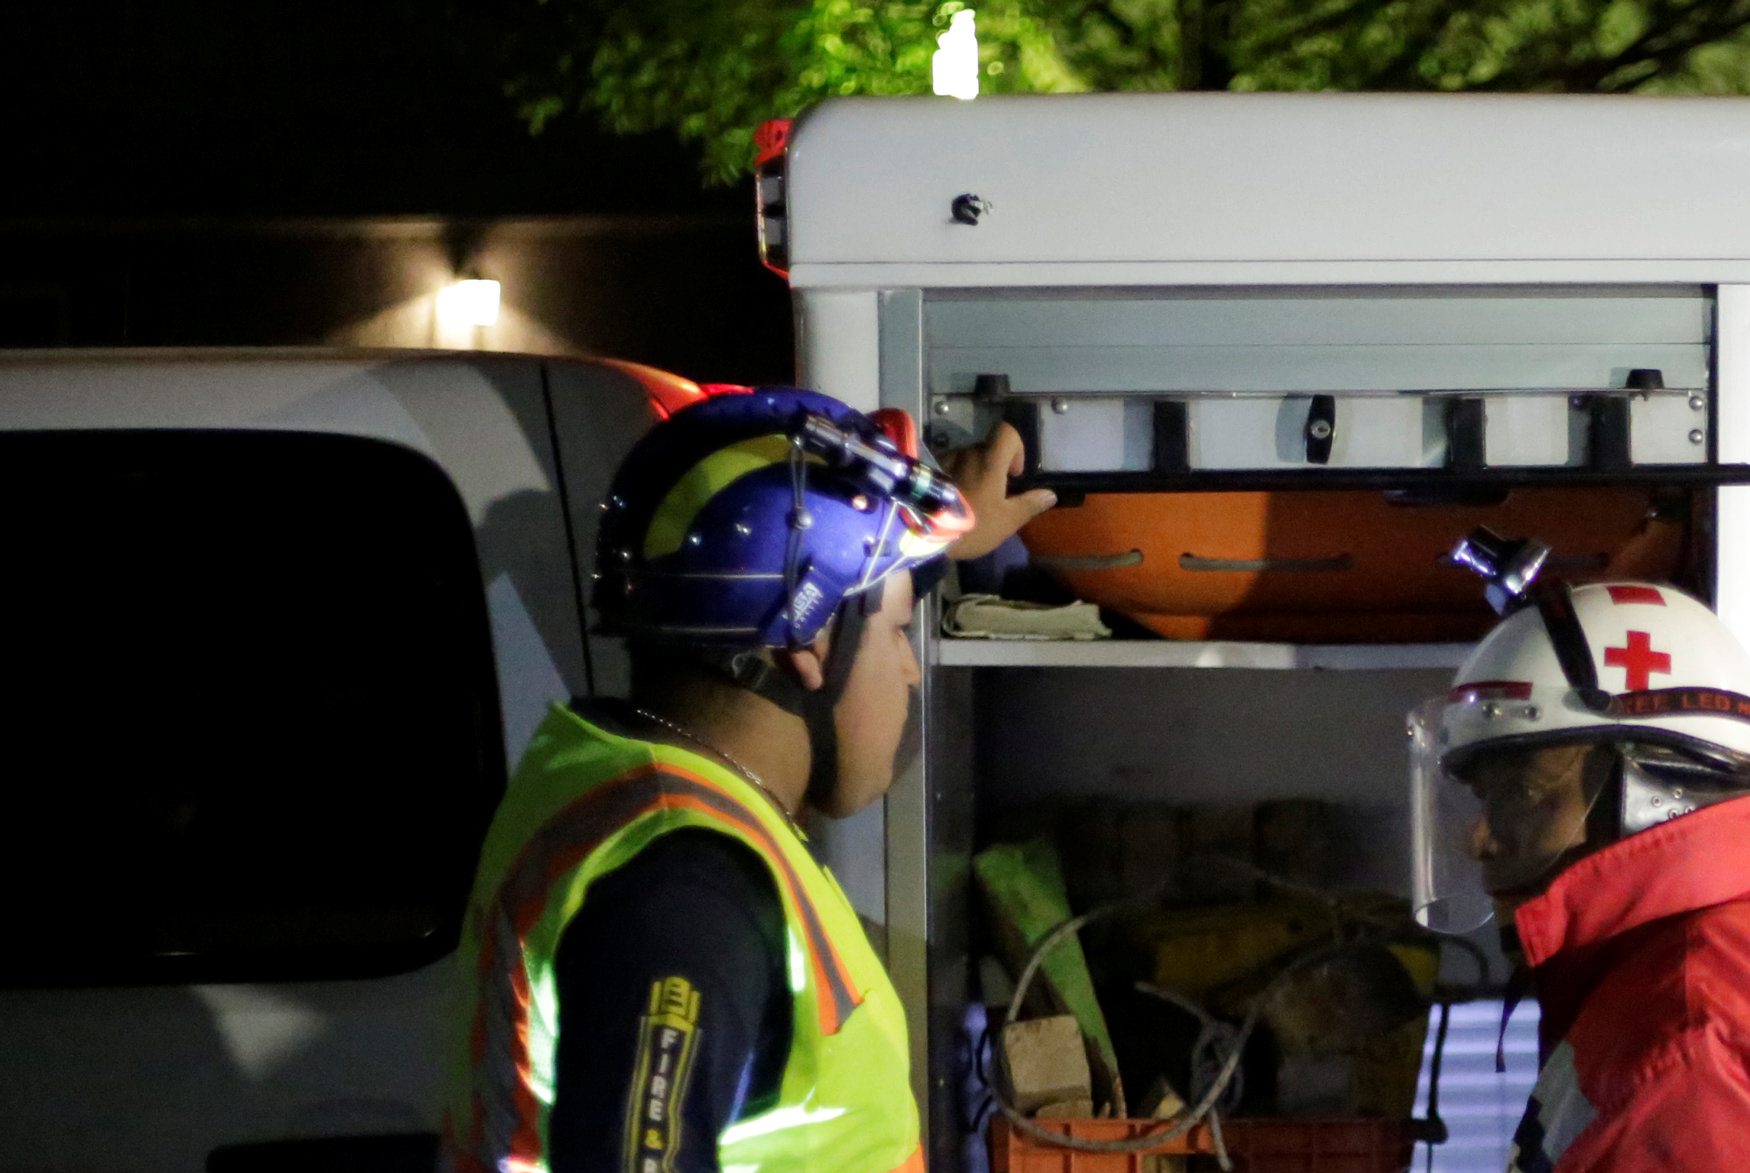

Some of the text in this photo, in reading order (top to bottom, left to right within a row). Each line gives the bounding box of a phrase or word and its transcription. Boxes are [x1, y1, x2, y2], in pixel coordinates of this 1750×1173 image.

[1681, 691, 1732, 711] LED
[648, 1028, 679, 1122] FIRE
[643, 1127, 663, 1150] &
